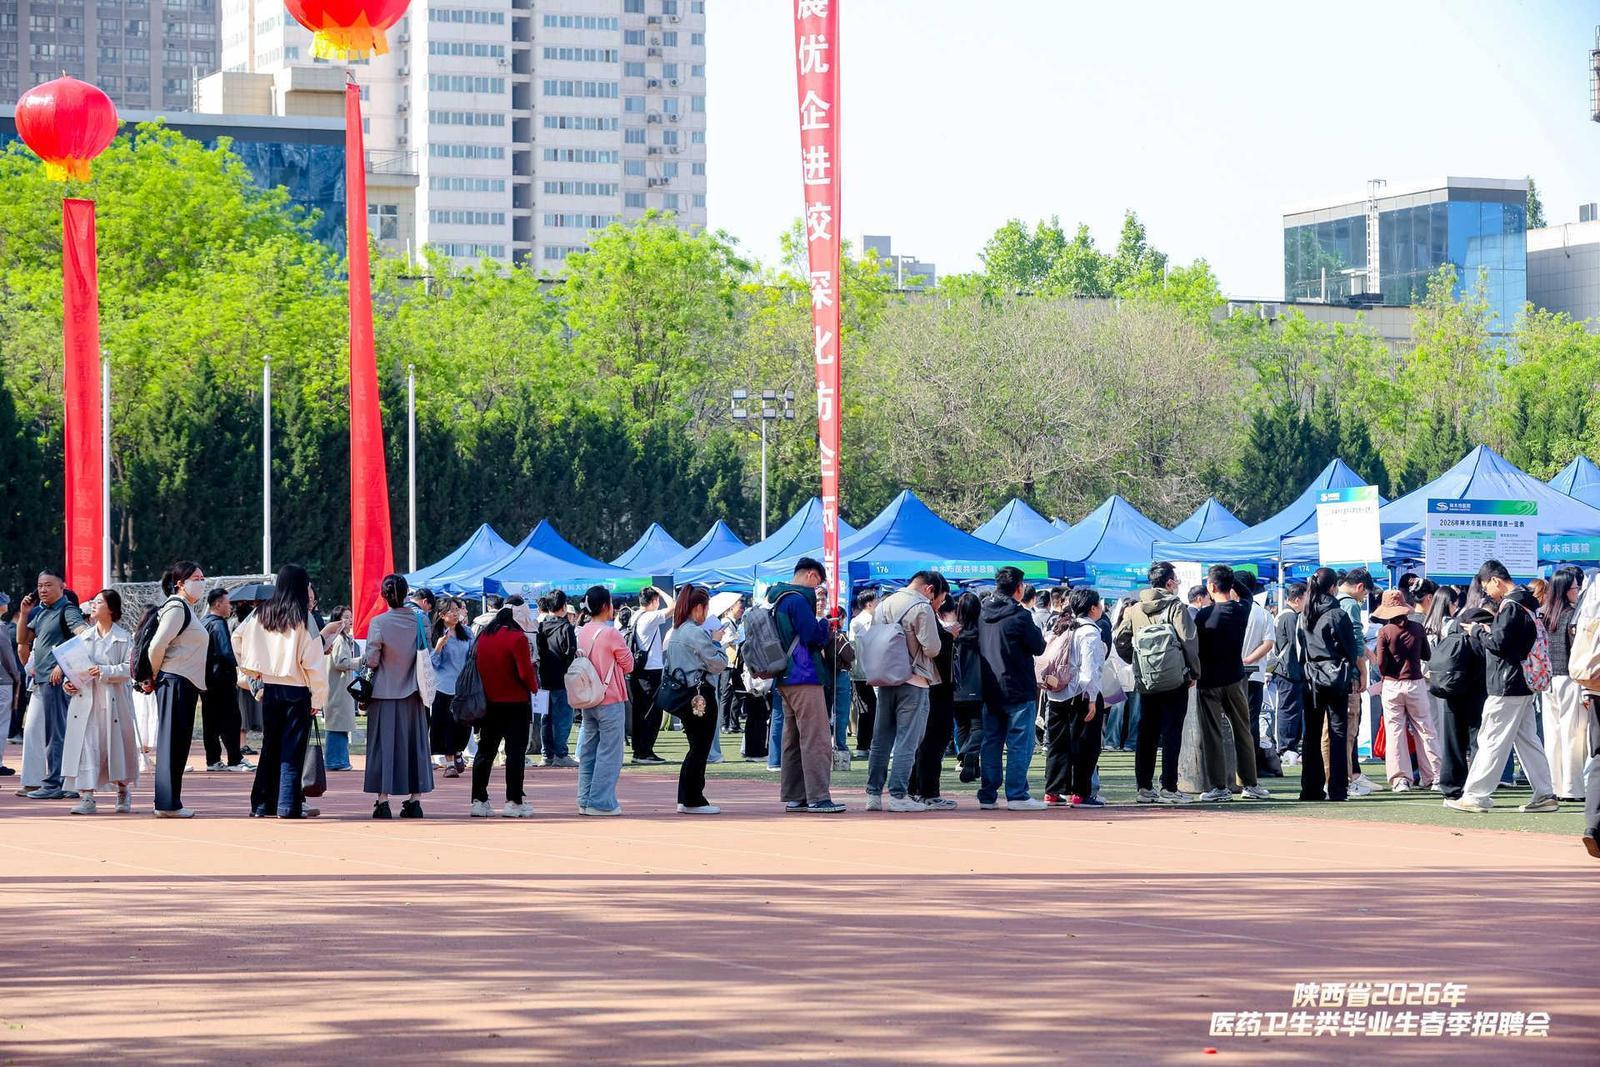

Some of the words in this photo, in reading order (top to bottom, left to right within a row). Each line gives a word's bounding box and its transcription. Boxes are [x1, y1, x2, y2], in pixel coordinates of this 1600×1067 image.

[1542, 543, 1591, 554] 神木市医院
